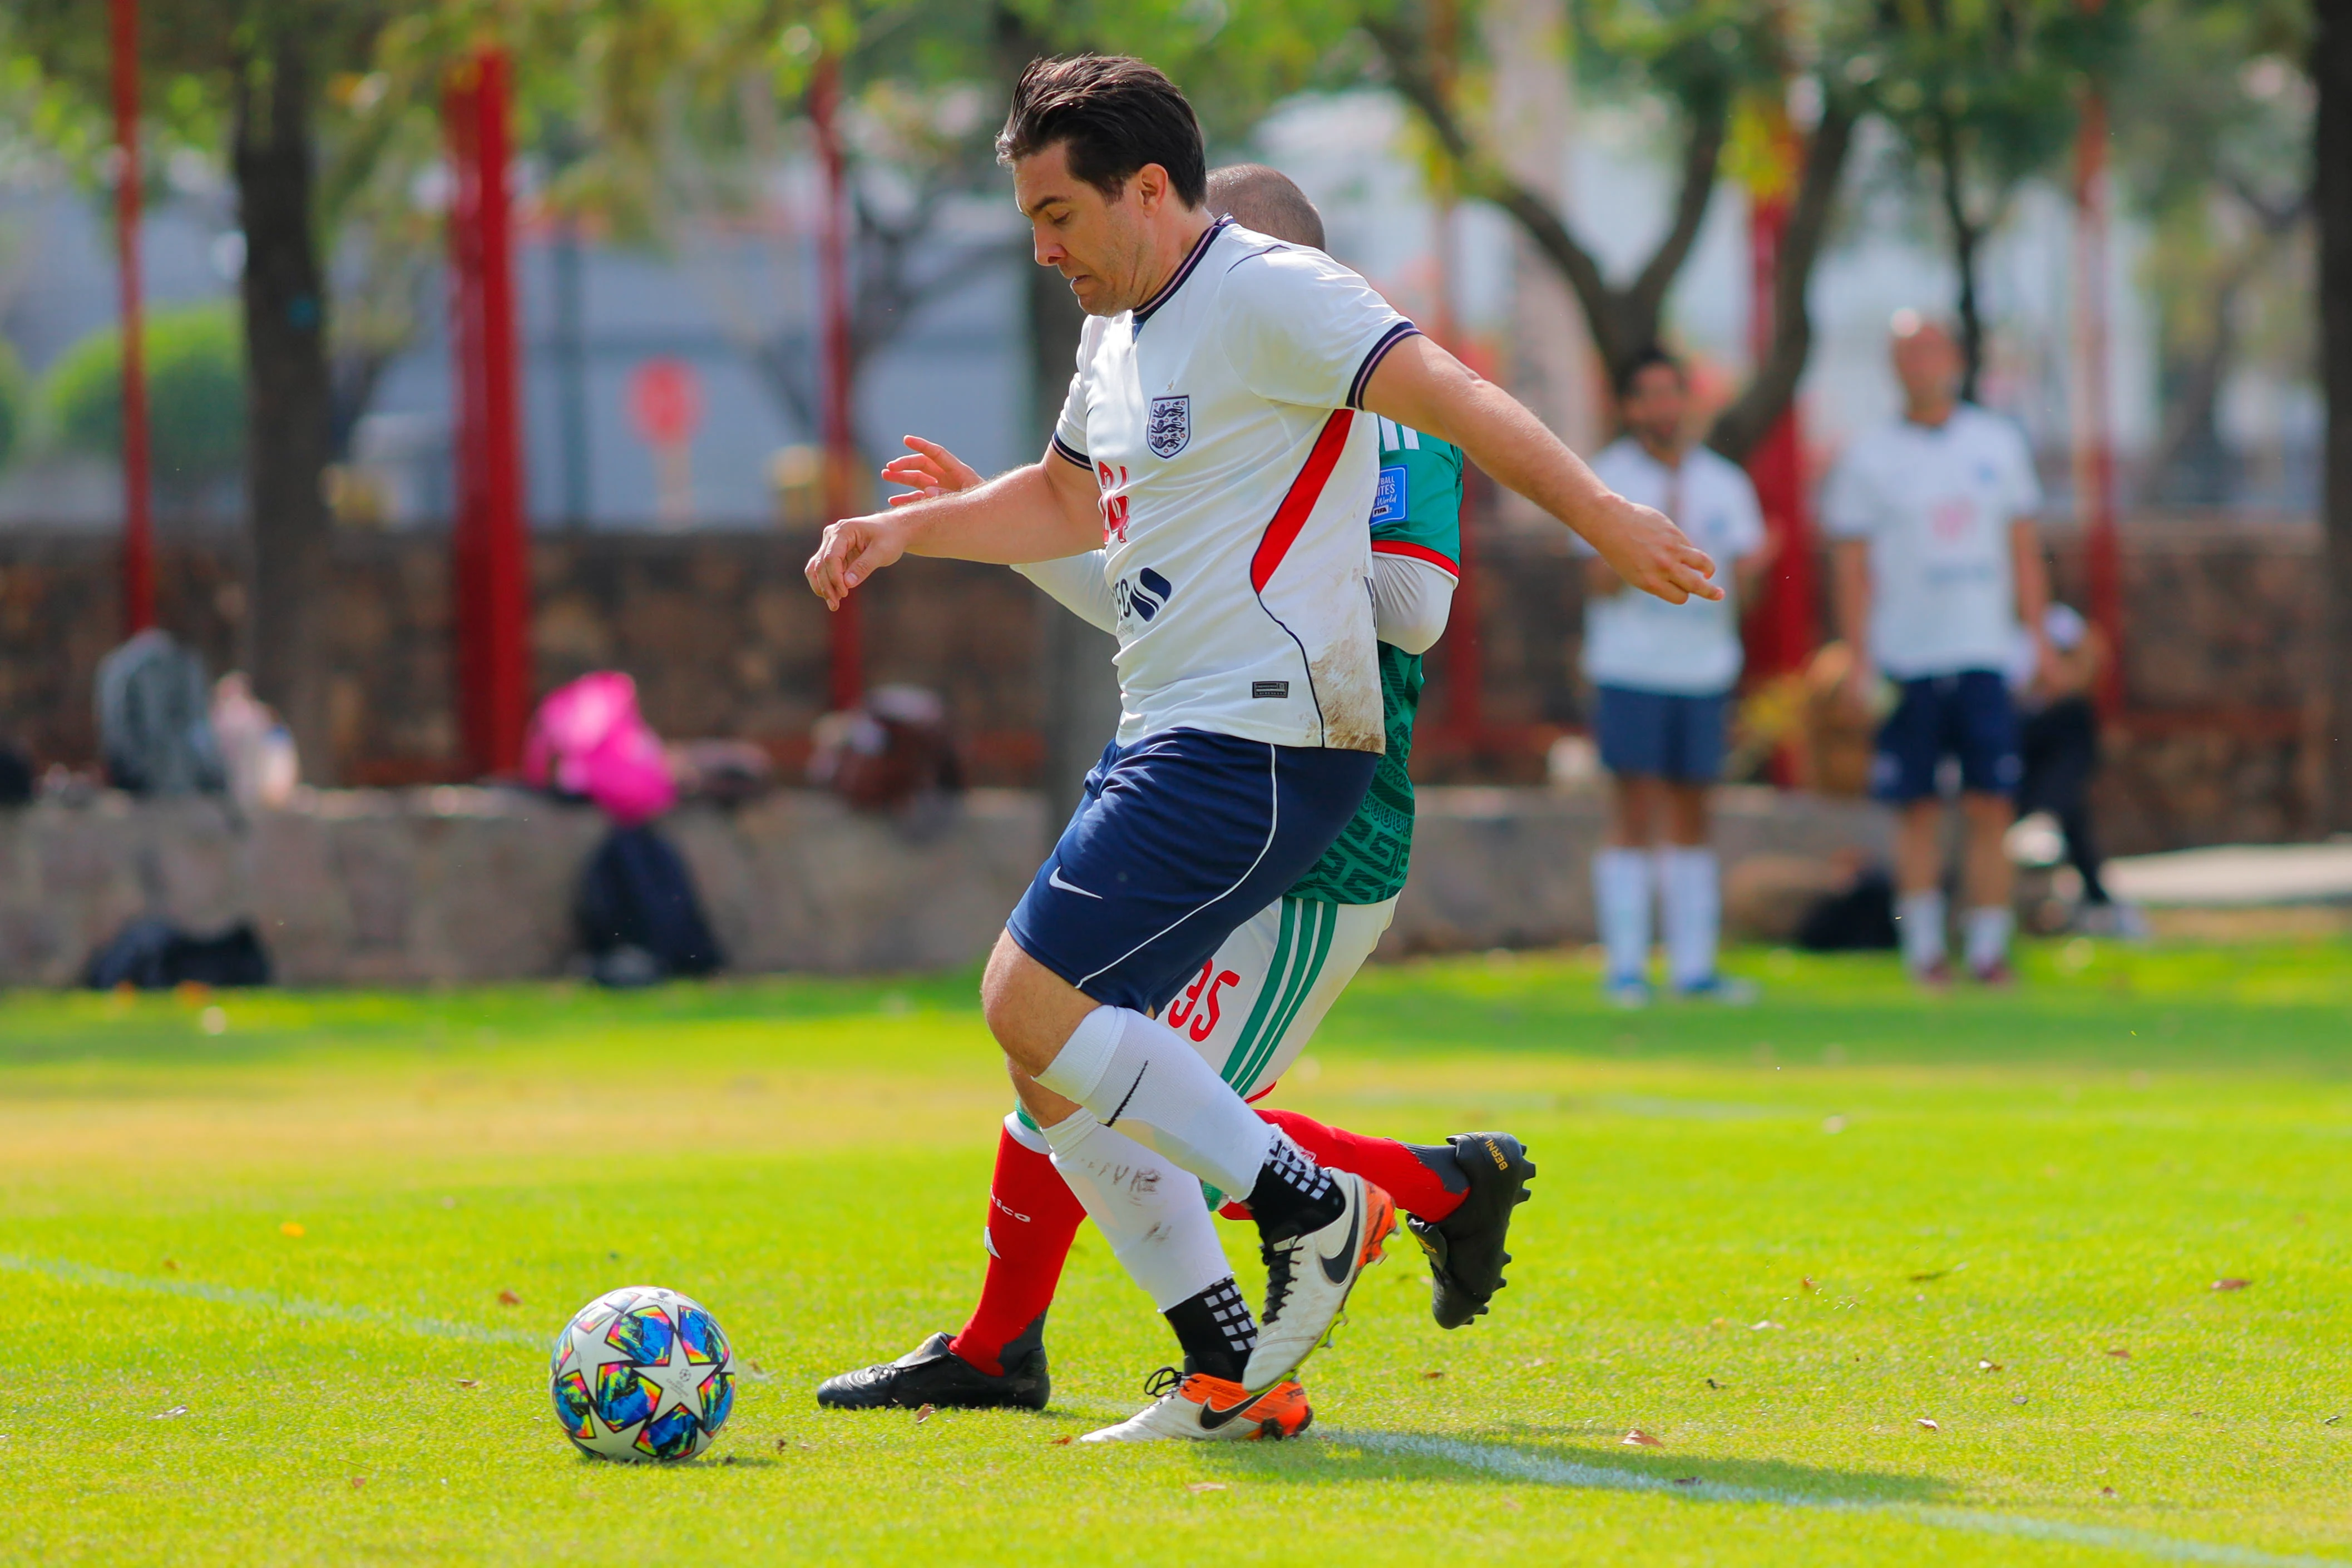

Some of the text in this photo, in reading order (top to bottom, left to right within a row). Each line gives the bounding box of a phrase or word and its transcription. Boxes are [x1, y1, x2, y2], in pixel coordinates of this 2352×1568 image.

[1377, 483, 1395, 496] ITES
[1377, 494, 1397, 506] World
[1373, 507, 1387, 516] FIFA
[1485, 1139, 1509, 1171] BERNI
